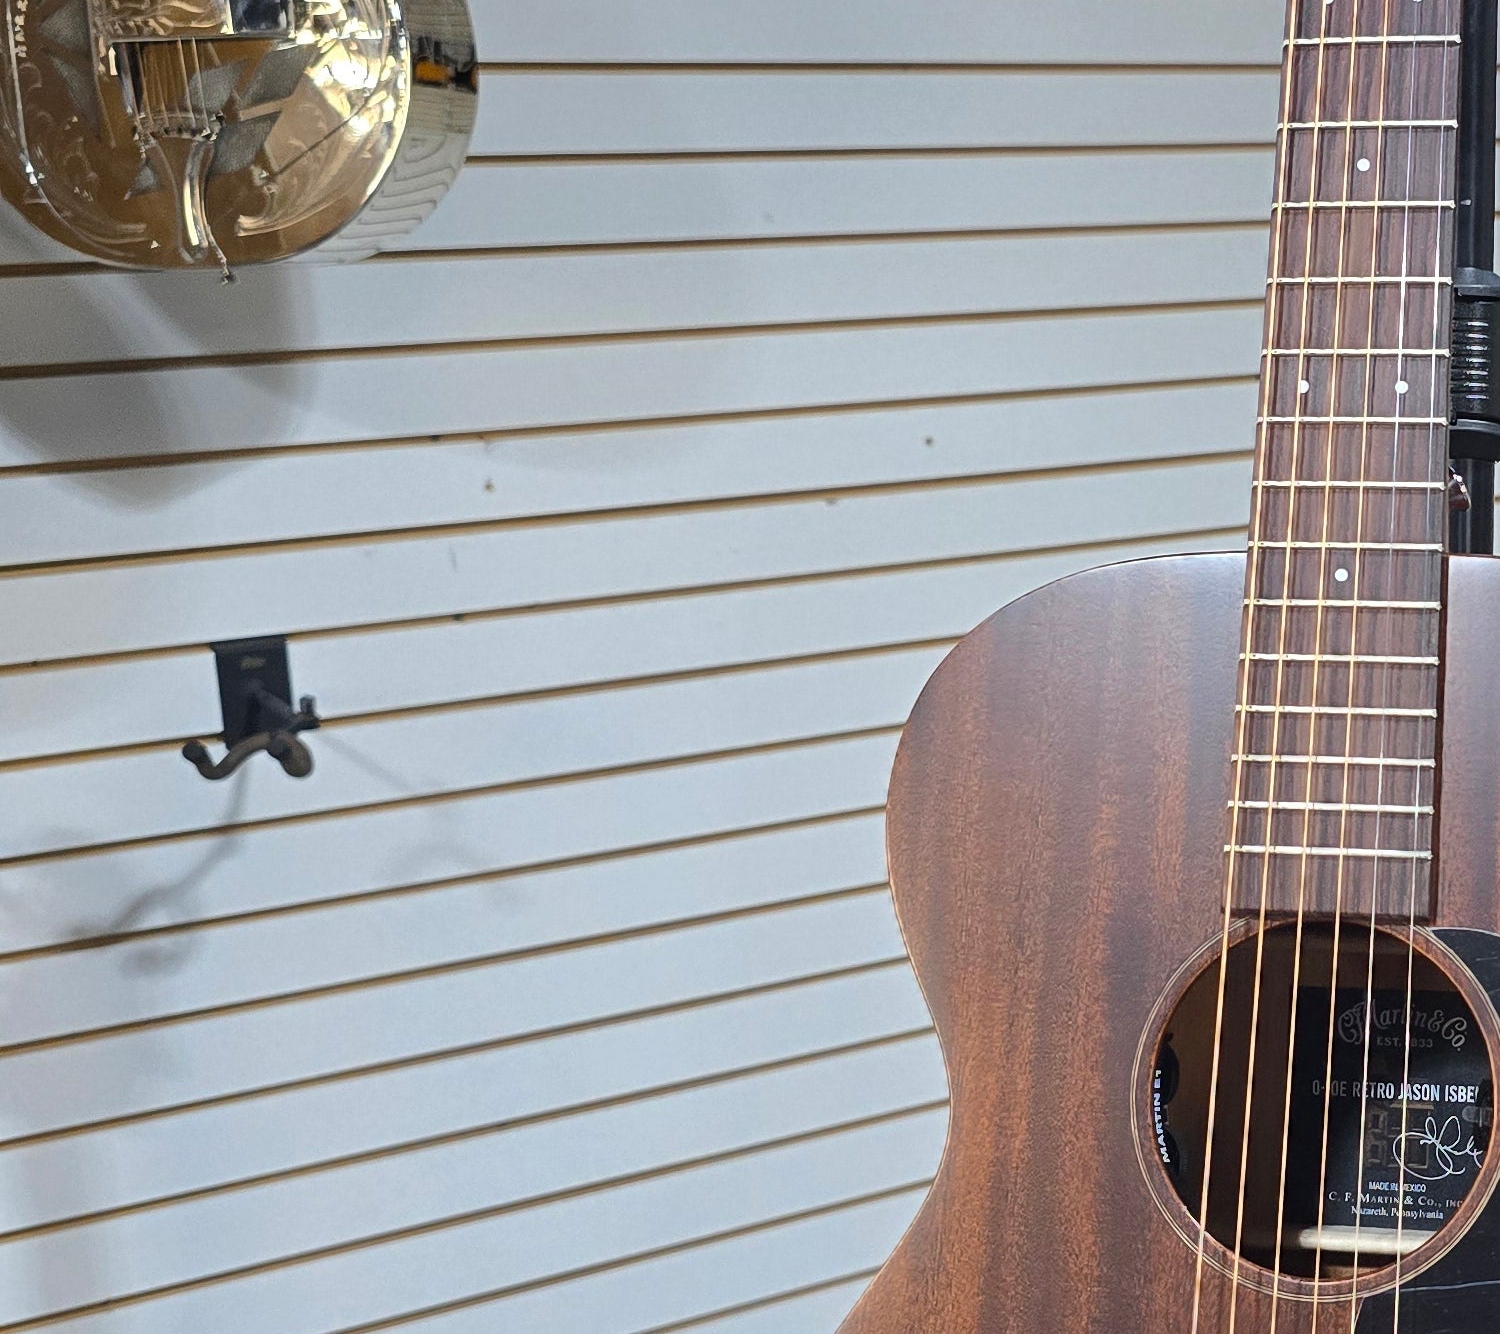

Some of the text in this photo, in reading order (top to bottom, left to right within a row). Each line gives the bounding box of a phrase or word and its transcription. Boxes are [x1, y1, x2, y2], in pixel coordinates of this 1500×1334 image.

[1352, 1080, 1395, 1100] RETRO
[1397, 1082, 1440, 1102] JASON
[1153, 1092, 1171, 1164] MARTIN
[1368, 1181, 1390, 1191] MADE
